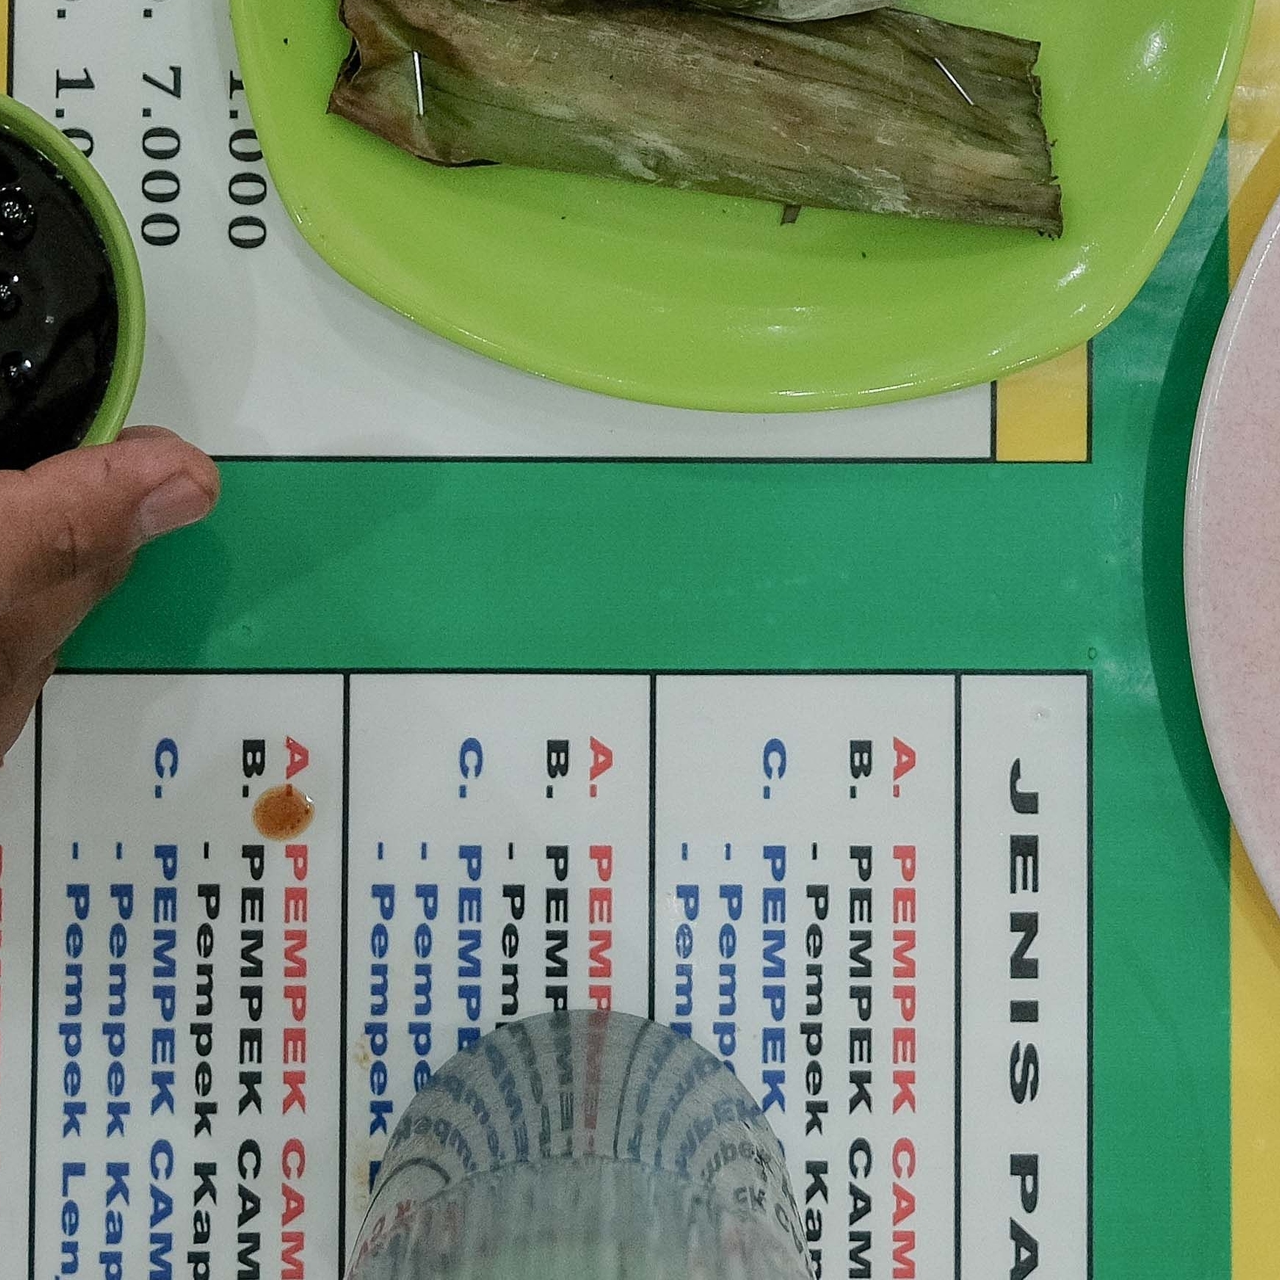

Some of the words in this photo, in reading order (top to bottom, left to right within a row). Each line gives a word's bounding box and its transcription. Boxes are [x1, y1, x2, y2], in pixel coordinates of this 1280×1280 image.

[140, 65, 182, 247] 7.000
[154, 737, 179, 799] C.
[242, 739, 265, 798] B.
[285, 735, 308, 796] A.
[458, 737, 484, 799] C.
[545, 739, 570, 799] B.
[589, 735, 614, 798] A.
[762, 737, 787, 800] C.
[849, 739, 873, 800] B.
[892, 736, 917, 799] A.
[150, 843, 179, 1116] PEMPEK
[237, 844, 265, 1117] PEMPEK
[282, 843, 309, 1116] PEMPEK
[496, 885, 525, 1029] Pem
[762, 845, 786, 1113] PEMPEK
[848, 845, 873, 1116] PEMPEK
[892, 844, 917, 1115] PEMPEK
[1008, 757, 1040, 1105] JENIS
[58, 882, 91, 1139] Pempek
[101, 883, 135, 1139] Pempek
[189, 883, 221, 1139] Pempek
[363, 883, 396, 1139] Pempek
[799, 884, 830, 1137] Pempek
[55, 1161, 86, 1280] Len
[98, 1161, 131, 1280] Kap
[148, 1138, 175, 1280] CAM
[186, 1161, 218, 1280] Kap
[236, 1138, 262, 1280] CAM
[280, 1137, 306, 1280] CAM
[847, 1137, 873, 1280] CAM
[891, 1137, 917, 1280] CAM
[1010, 1154, 1039, 1280] PA
